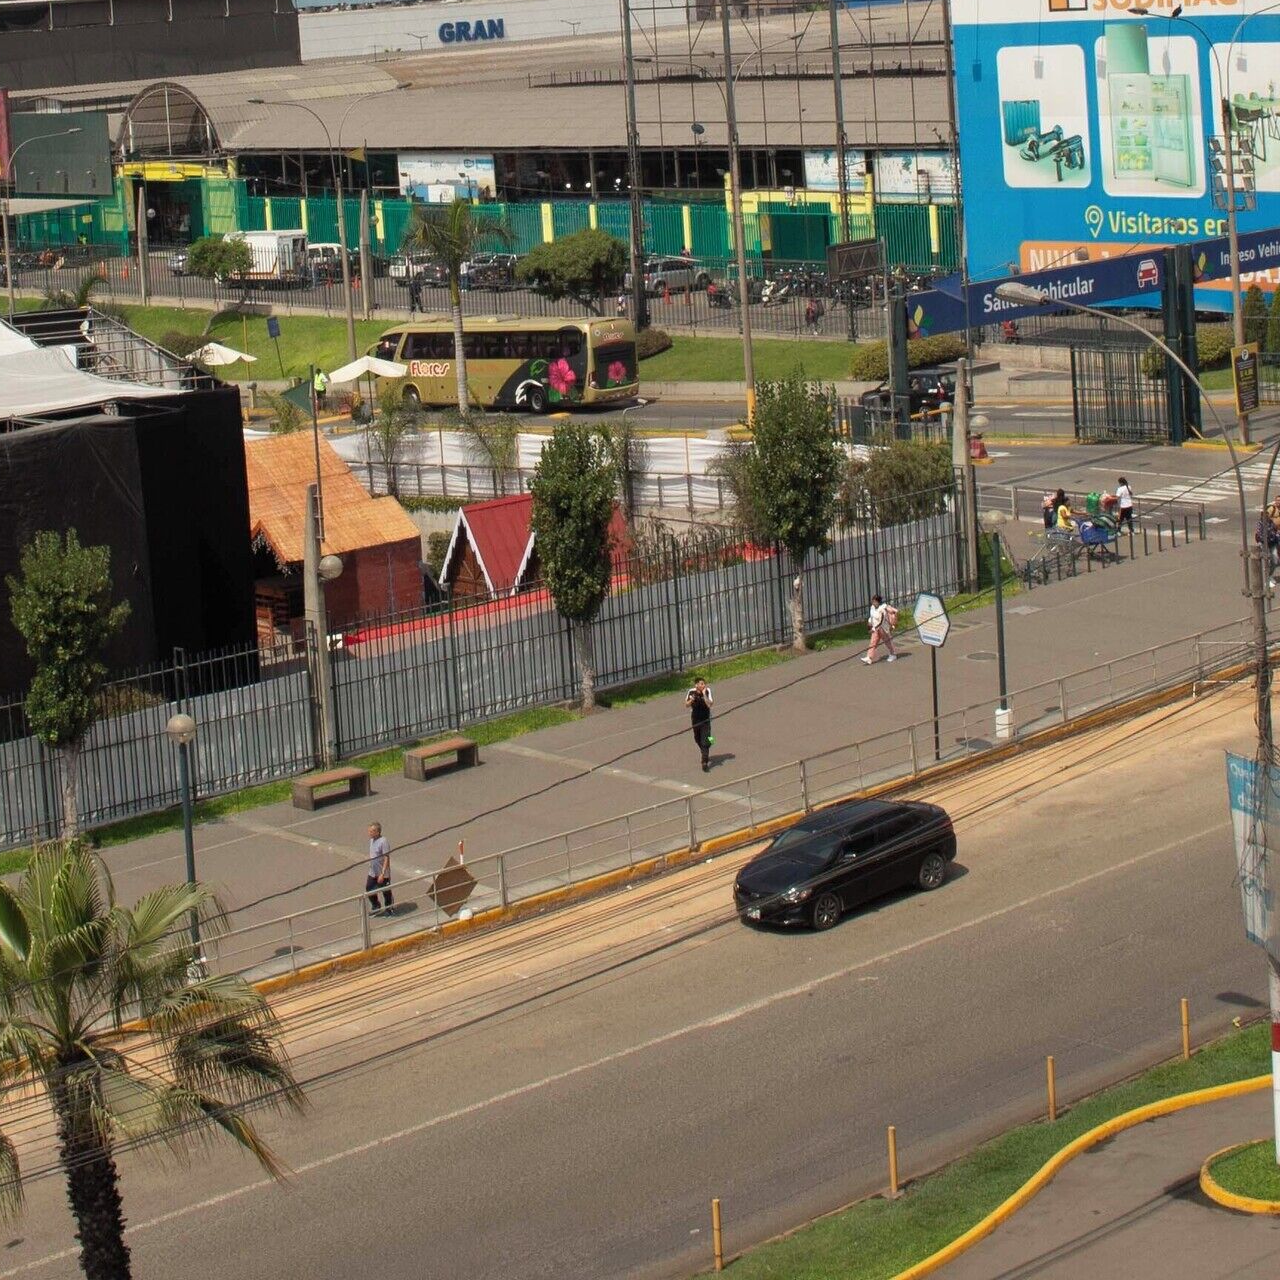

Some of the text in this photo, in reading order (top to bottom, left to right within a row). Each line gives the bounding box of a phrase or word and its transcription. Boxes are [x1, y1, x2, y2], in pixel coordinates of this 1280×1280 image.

[438, 18, 504, 43] GRAN
[1108, 210, 1199, 236] Visítanos
[1220, 249, 1256, 266] Ineso
